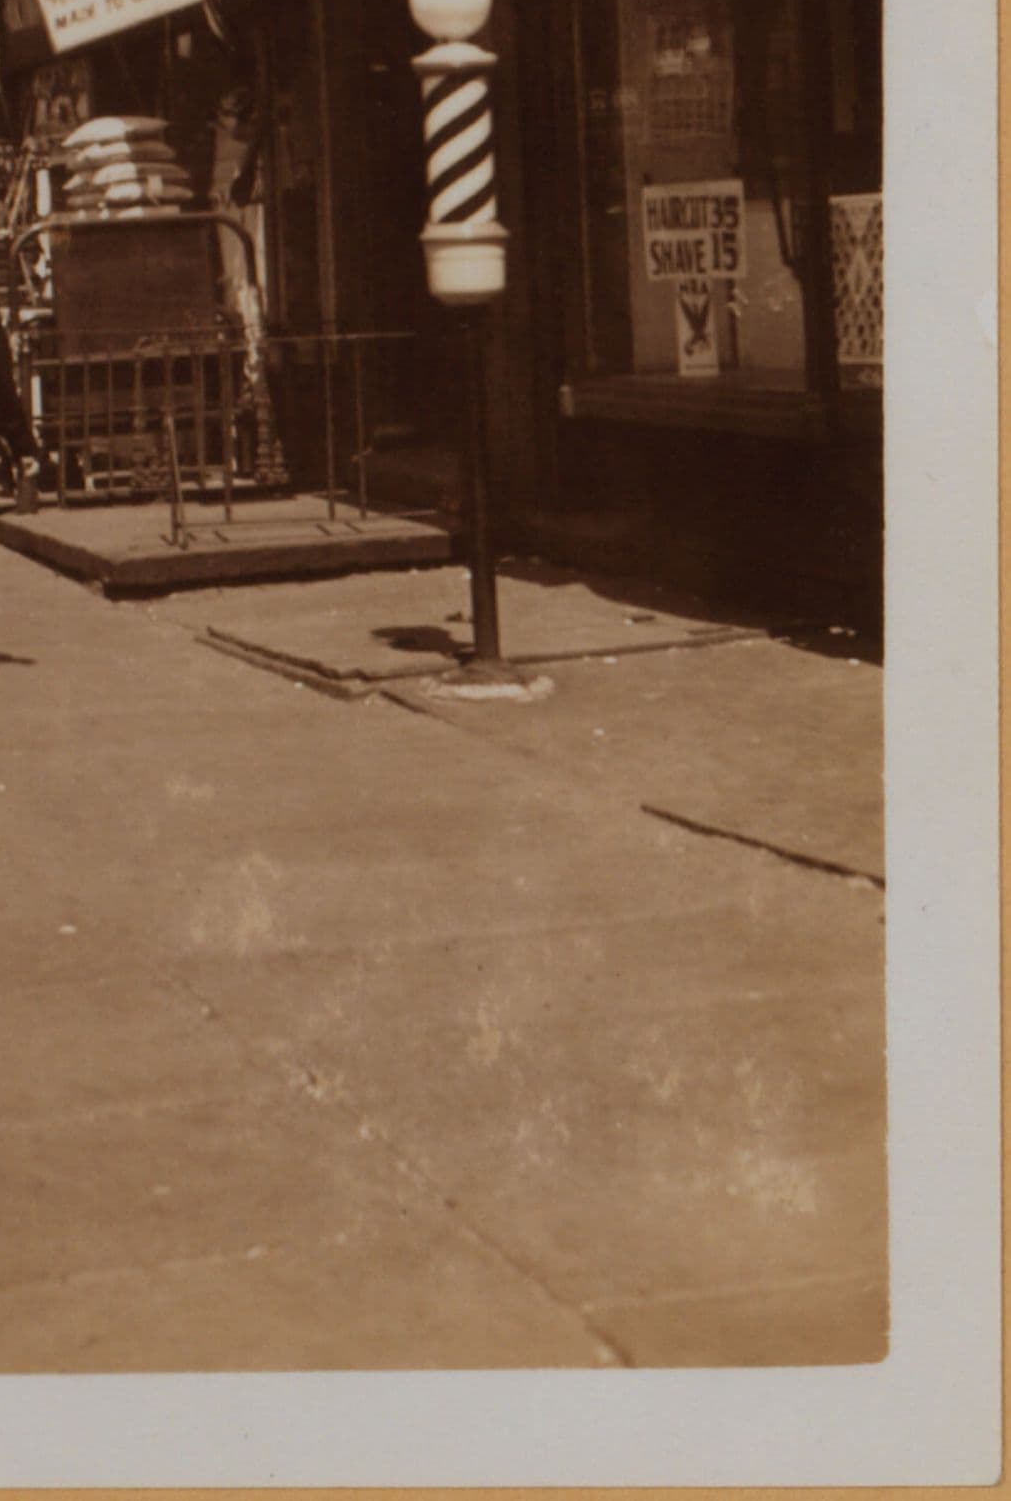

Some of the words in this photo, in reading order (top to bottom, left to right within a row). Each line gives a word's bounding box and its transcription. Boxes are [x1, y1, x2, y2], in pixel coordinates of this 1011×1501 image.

[646, 196, 708, 231] HAIRCUT
[710, 195, 739, 229] 35
[650, 239, 707, 275] SHAVE
[711, 232, 738, 271] 15
